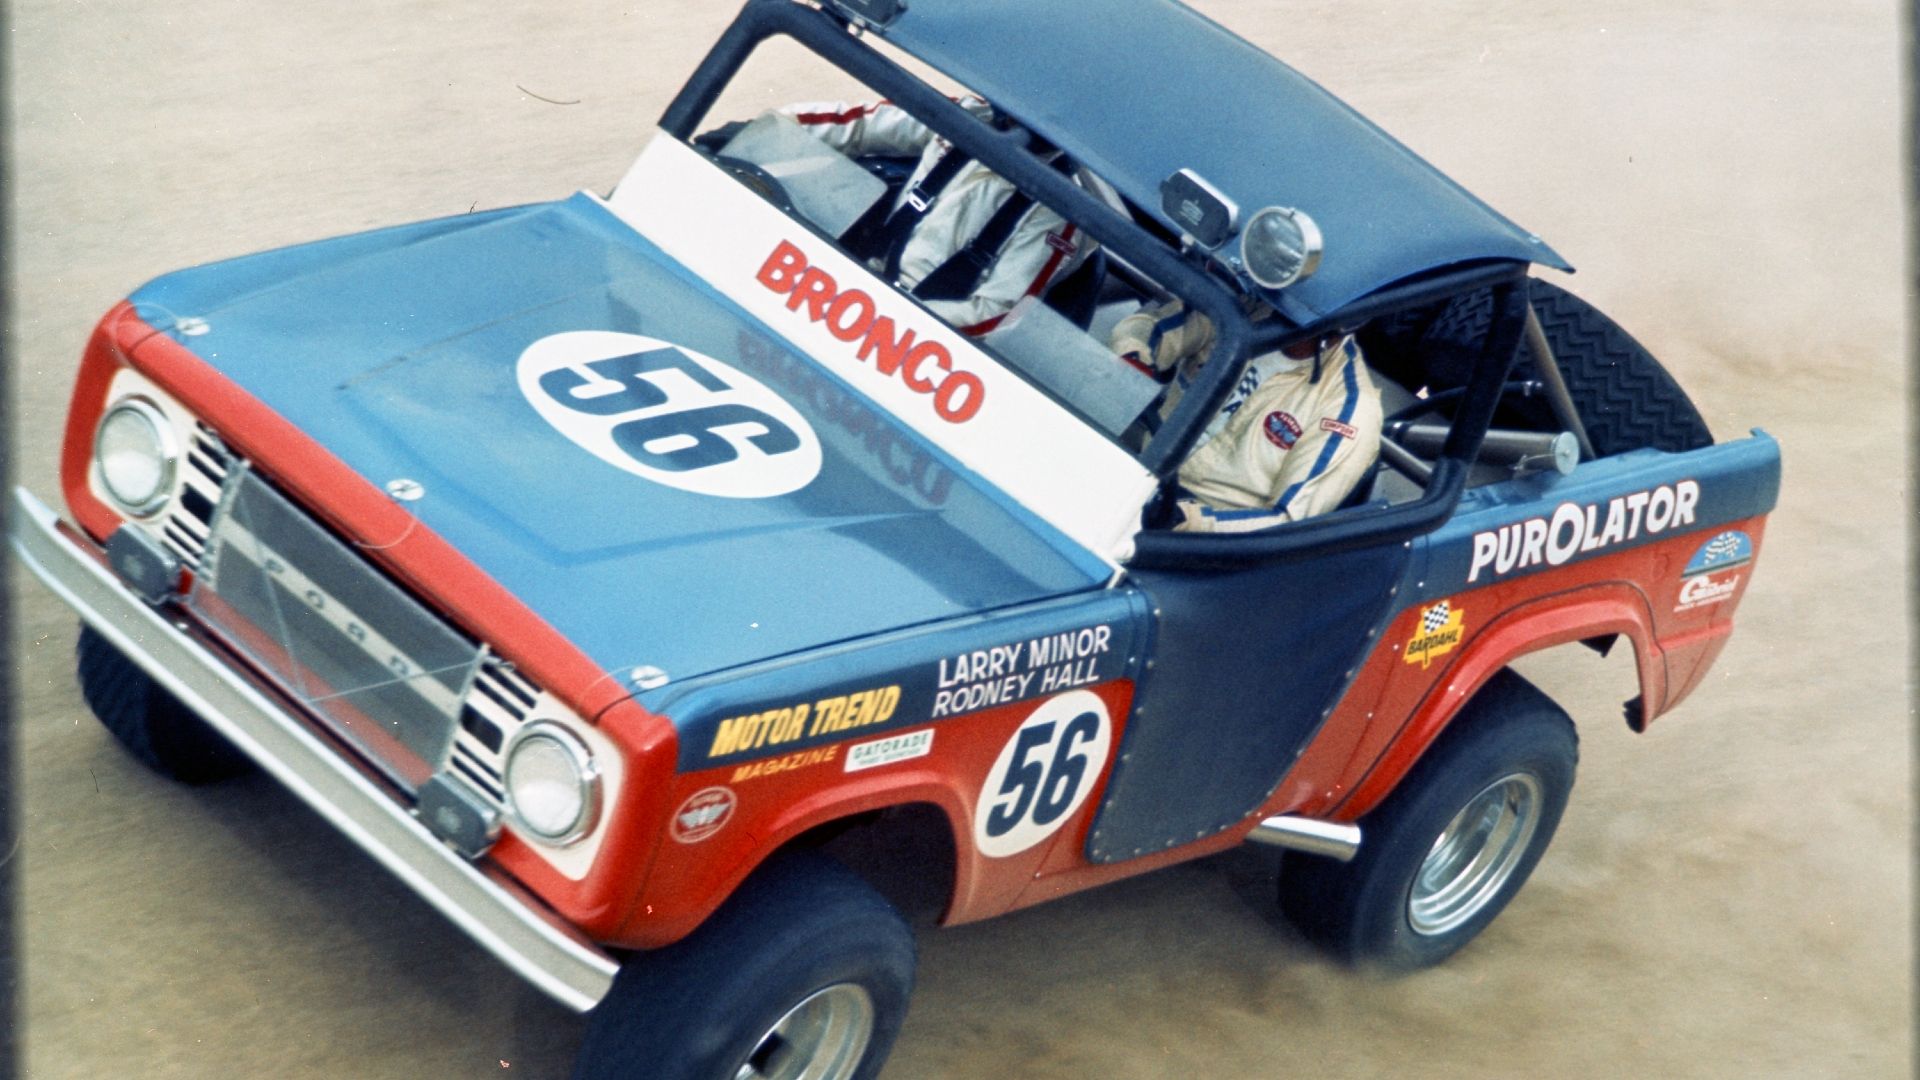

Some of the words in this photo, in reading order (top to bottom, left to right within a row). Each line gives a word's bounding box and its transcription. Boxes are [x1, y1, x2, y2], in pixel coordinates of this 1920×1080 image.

[755, 239, 985, 424] BRONCO
[538, 346, 801, 472] 56
[1467, 480, 1699, 583] PUROLATOR
[938, 642, 1022, 688] LARRY
[1028, 625, 1111, 669] MINOR
[1407, 629, 1458, 655] BARDAHL
[708, 704, 811, 758] MOTOR
[808, 685, 901, 738] TREND
[932, 671, 1034, 718] RODNEY
[1040, 658, 1099, 693] HALL
[730, 744, 841, 783] MAGAZINE
[853, 732, 929, 759] GATORADE
[986, 711, 1100, 837] 56
